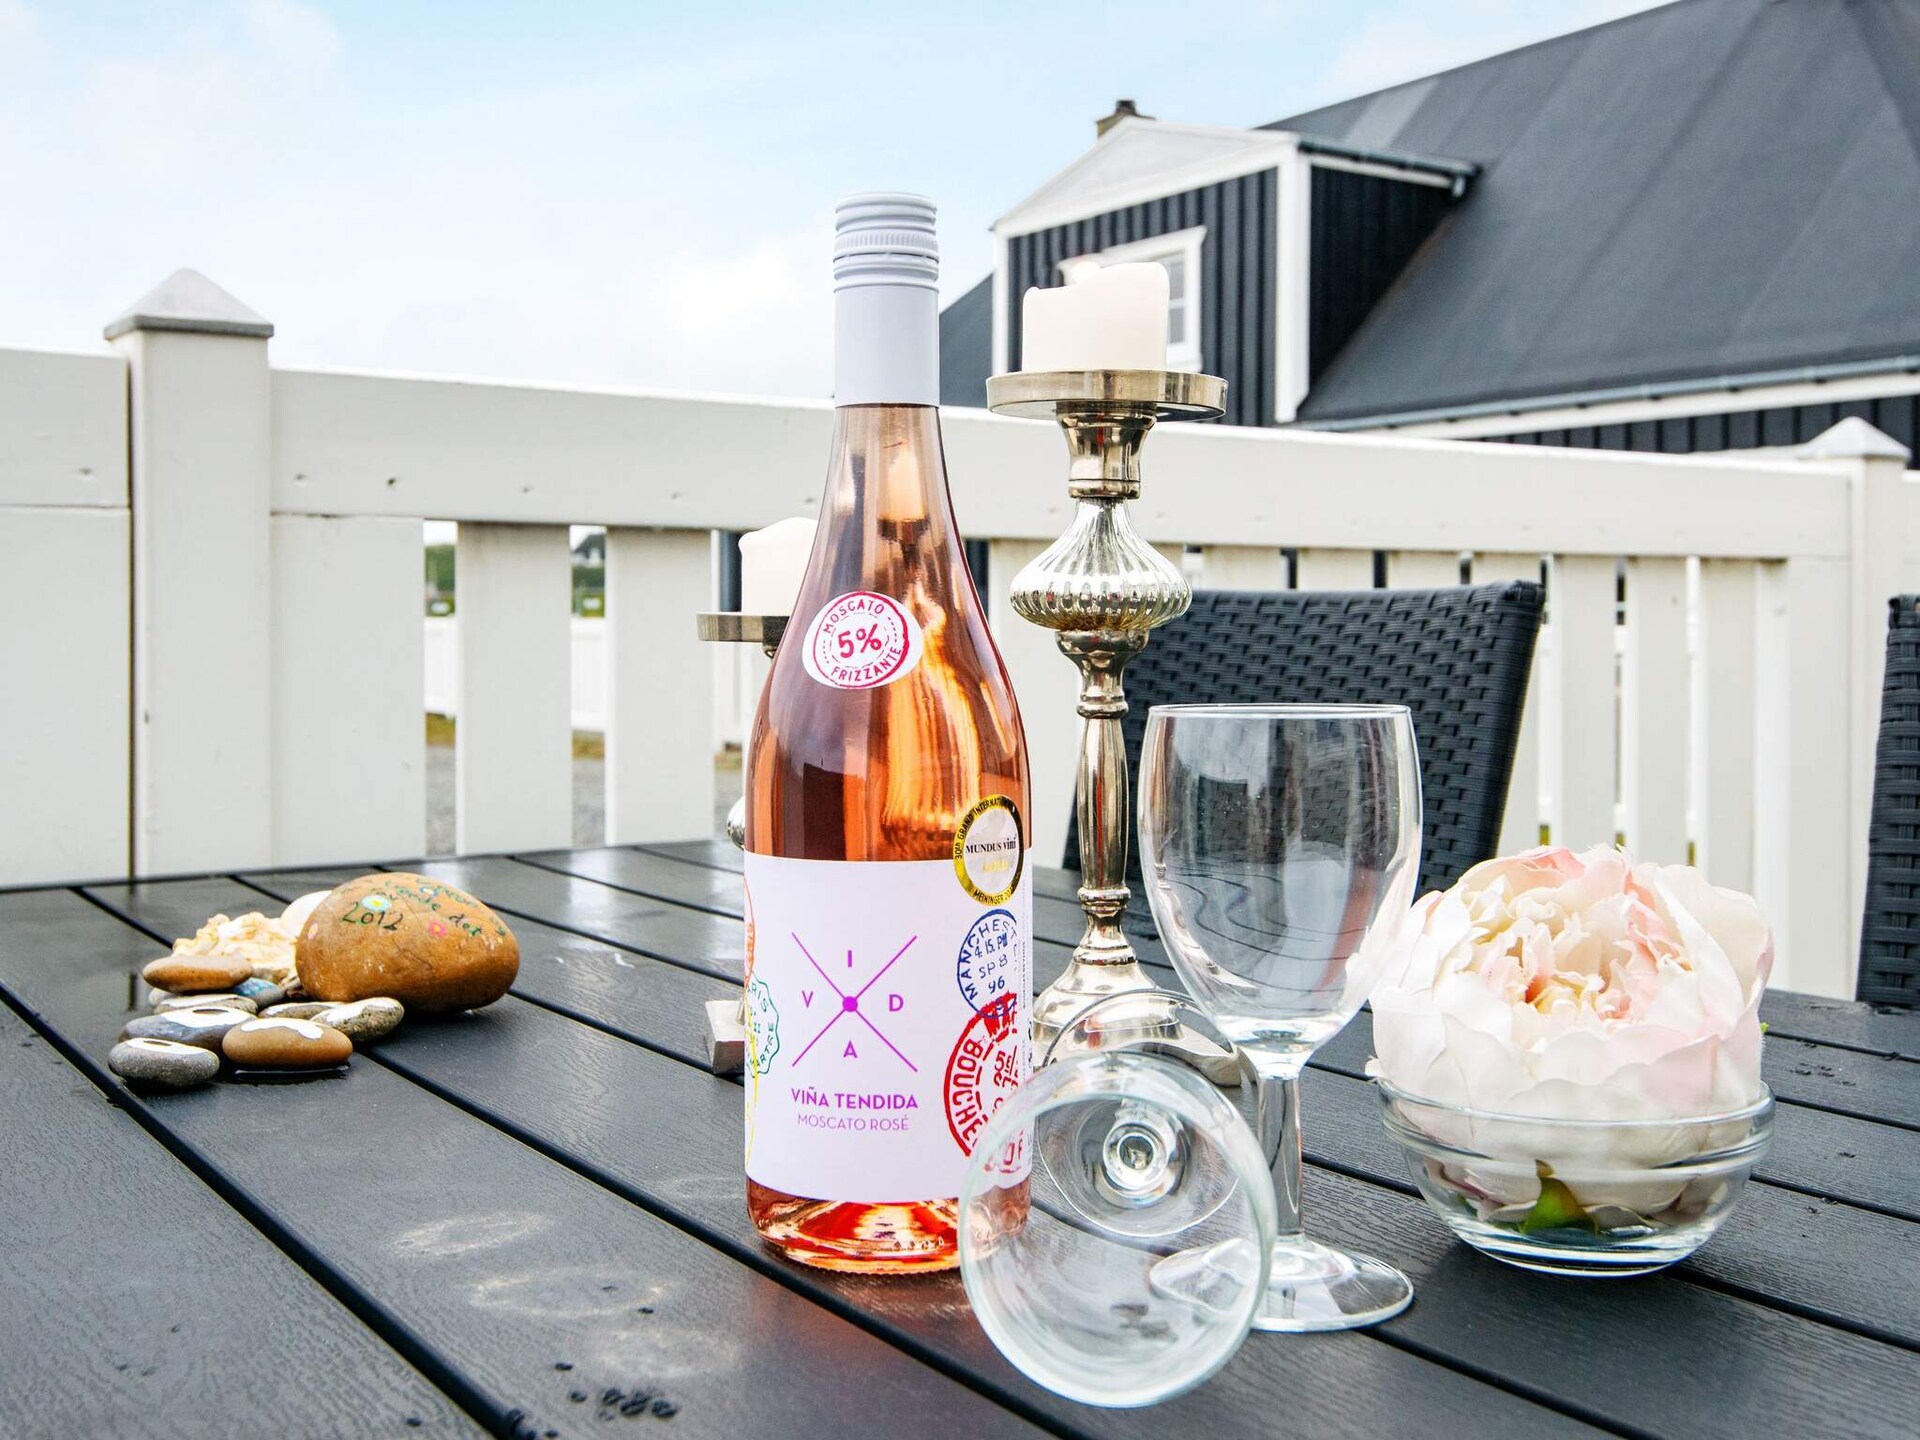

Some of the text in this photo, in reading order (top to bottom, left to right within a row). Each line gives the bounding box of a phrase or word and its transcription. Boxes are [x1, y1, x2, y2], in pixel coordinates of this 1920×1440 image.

[823, 599, 885, 634] MOSCATO
[838, 623, 882, 659] 5%
[831, 646, 902, 682] FRIZZANTE
[965, 842, 1002, 854] MUNDUS
[341, 901, 404, 931] 2012
[791, 1086, 919, 1110] VIÑA TENDIDA
[952, 1038, 983, 1147] BOUCHE
[797, 1113, 910, 1131] MOSCATO ROSÉ
